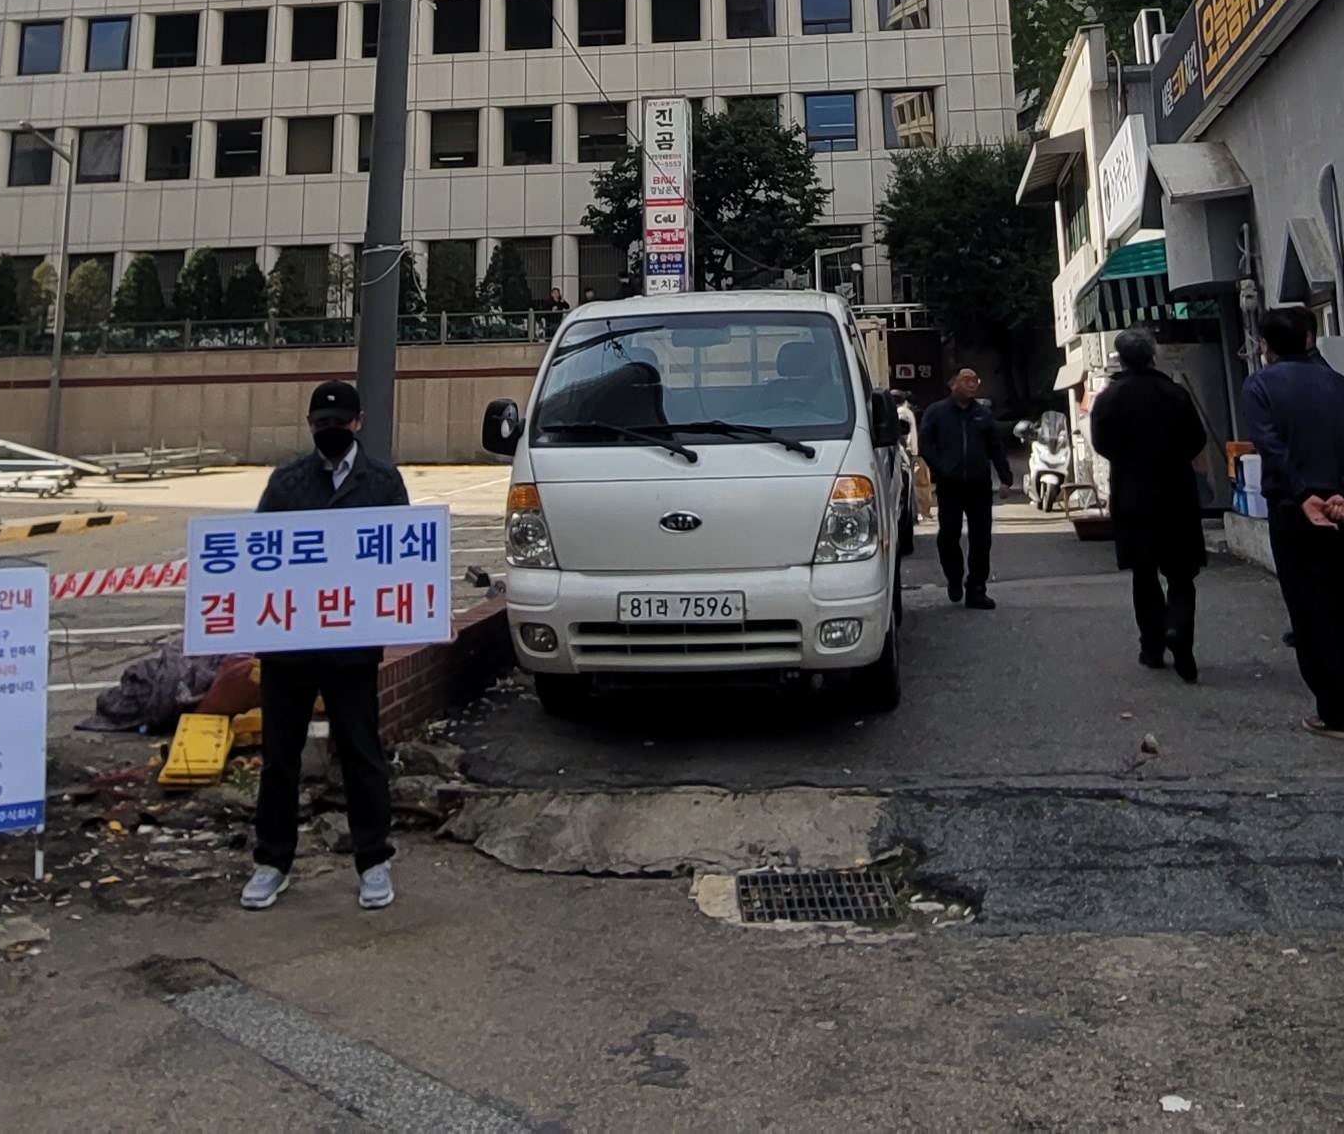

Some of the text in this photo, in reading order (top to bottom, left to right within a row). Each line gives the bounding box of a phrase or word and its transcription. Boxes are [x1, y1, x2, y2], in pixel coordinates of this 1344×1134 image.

[652, 175, 677, 185] BNK
[664, 515, 697, 528] KIA
[198, 521, 439, 574] 통행로 폐쇄
[629, 596, 732, 618] 81라 7596
